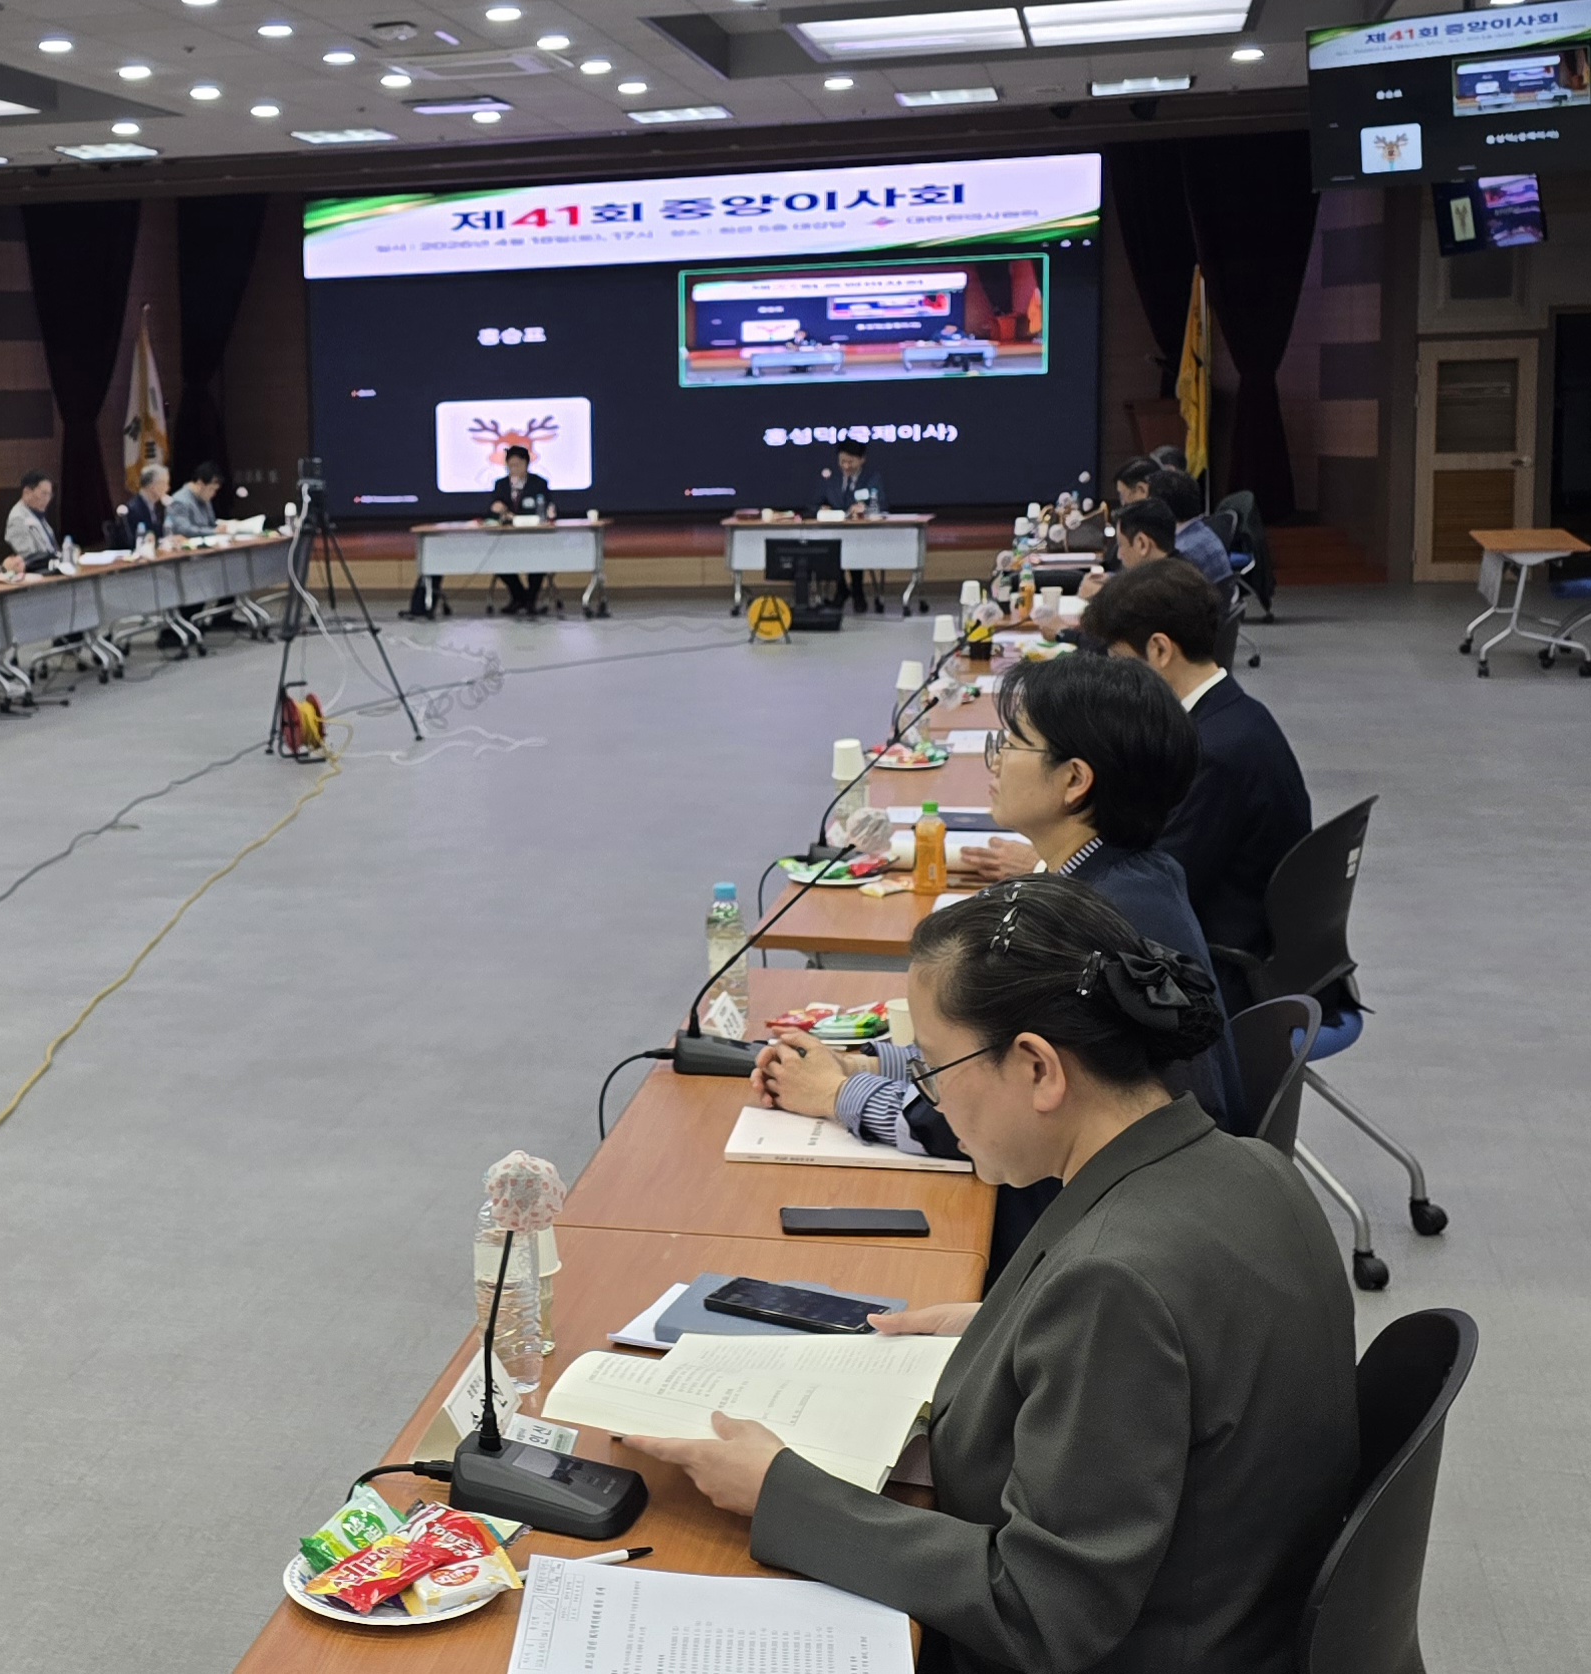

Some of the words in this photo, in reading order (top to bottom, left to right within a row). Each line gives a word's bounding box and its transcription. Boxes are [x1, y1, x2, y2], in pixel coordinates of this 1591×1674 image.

[1364, 26, 1439, 46] 제41회
[1445, 11, 1559, 36] 중앙이사회
[451, 201, 644, 231] 제41회
[659, 183, 966, 220] 중앙이사회
